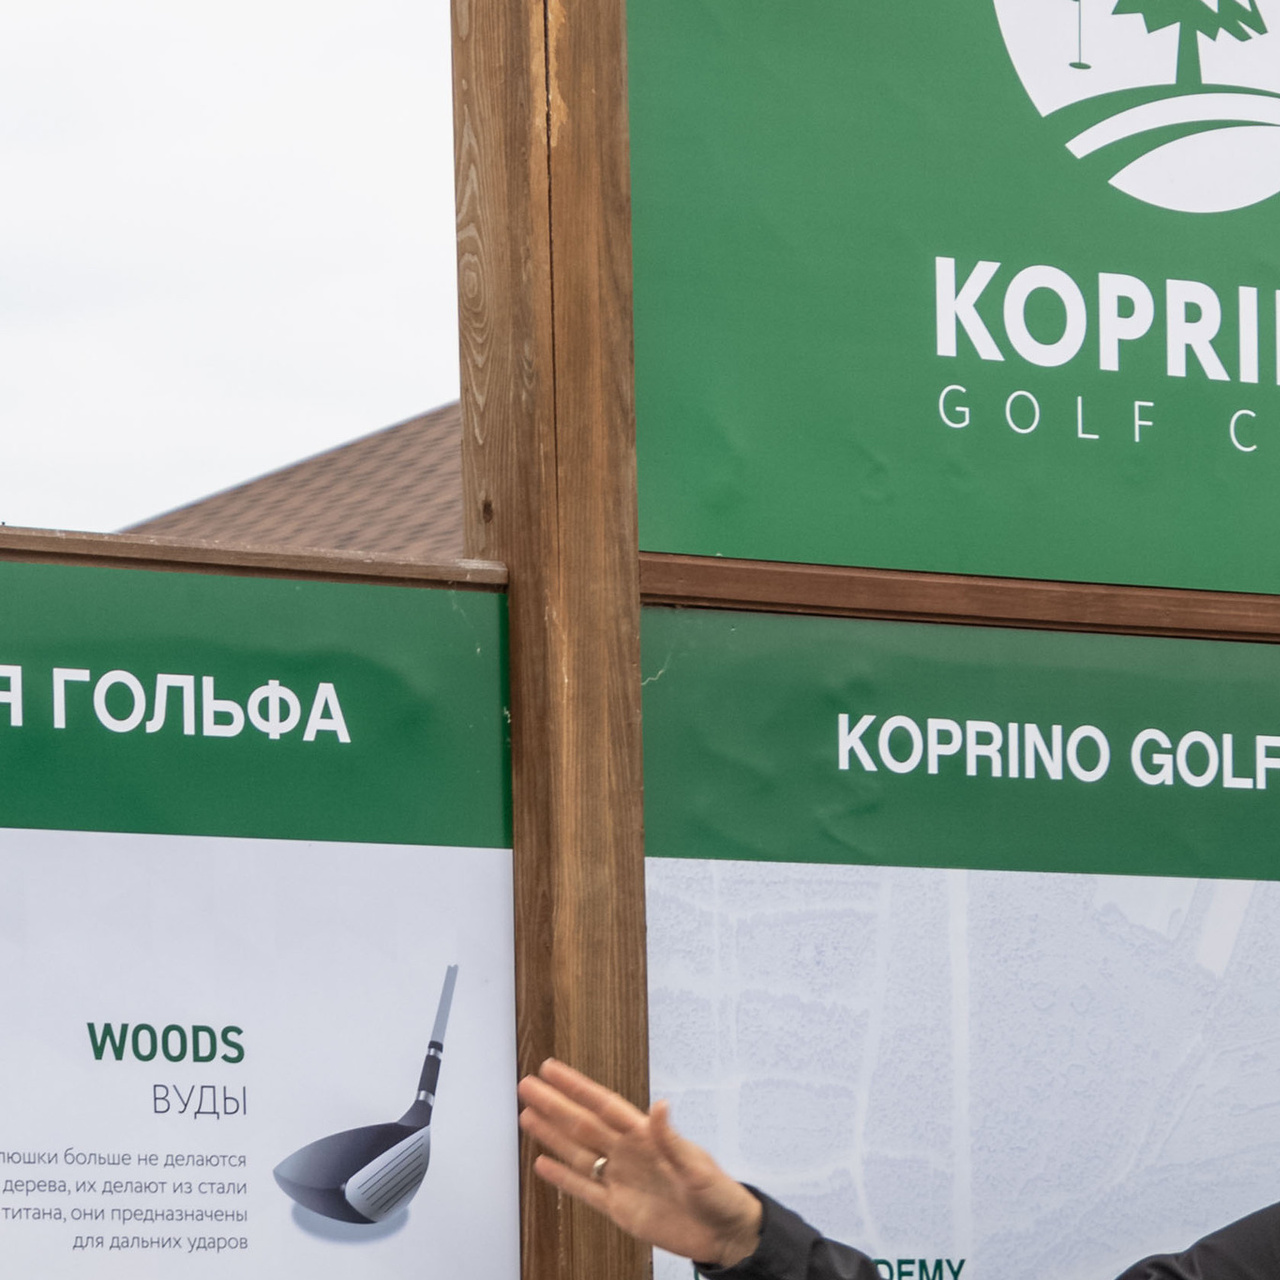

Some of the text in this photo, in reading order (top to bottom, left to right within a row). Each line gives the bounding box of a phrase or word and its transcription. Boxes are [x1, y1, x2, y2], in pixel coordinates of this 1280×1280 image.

[938, 385, 1155, 442] GOLF
[53, 668, 350, 743] ГОЛЬФА
[838, 713, 1110, 783] KOPRINO
[87, 1022, 245, 1063] WOODS
[152, 1084, 247, 1119] ВУДЫ
[63, 1145, 133, 1166] больше
[137, 1152, 160, 1166] не
[162, 1152, 247, 1169] делаются
[1, 1177, 248, 1196] дерева, их делают из стали
[0, 1205, 248, 1225] титана, они предназначены
[71, 1234, 249, 1253] для дальних ударов
